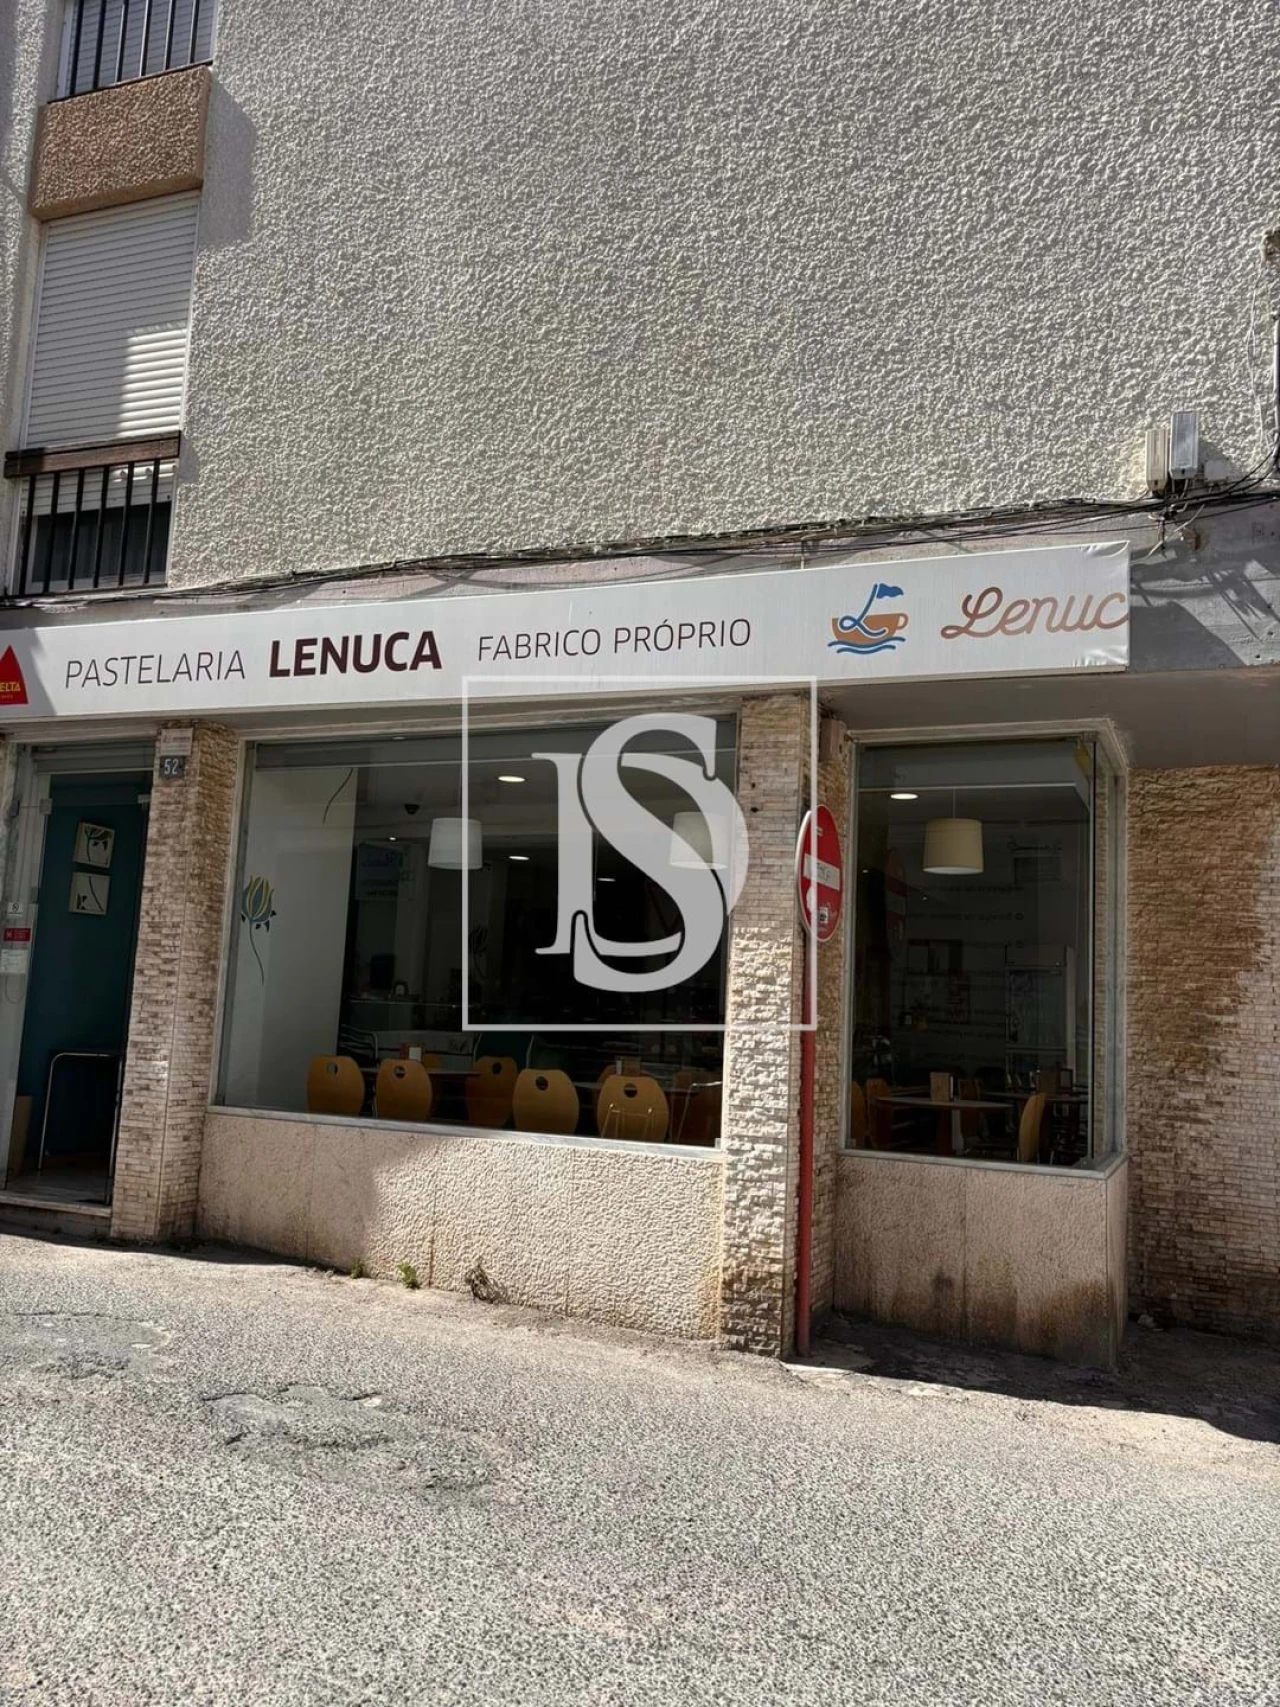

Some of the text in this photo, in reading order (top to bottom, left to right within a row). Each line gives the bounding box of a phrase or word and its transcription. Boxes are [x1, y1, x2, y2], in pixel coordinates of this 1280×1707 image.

[941, 587, 1129, 639] Lenuc
[66, 618, 751, 689] PASTELARIA LENUCA FABRICO PRÓPRIO
[164, 758, 179, 775] 52
